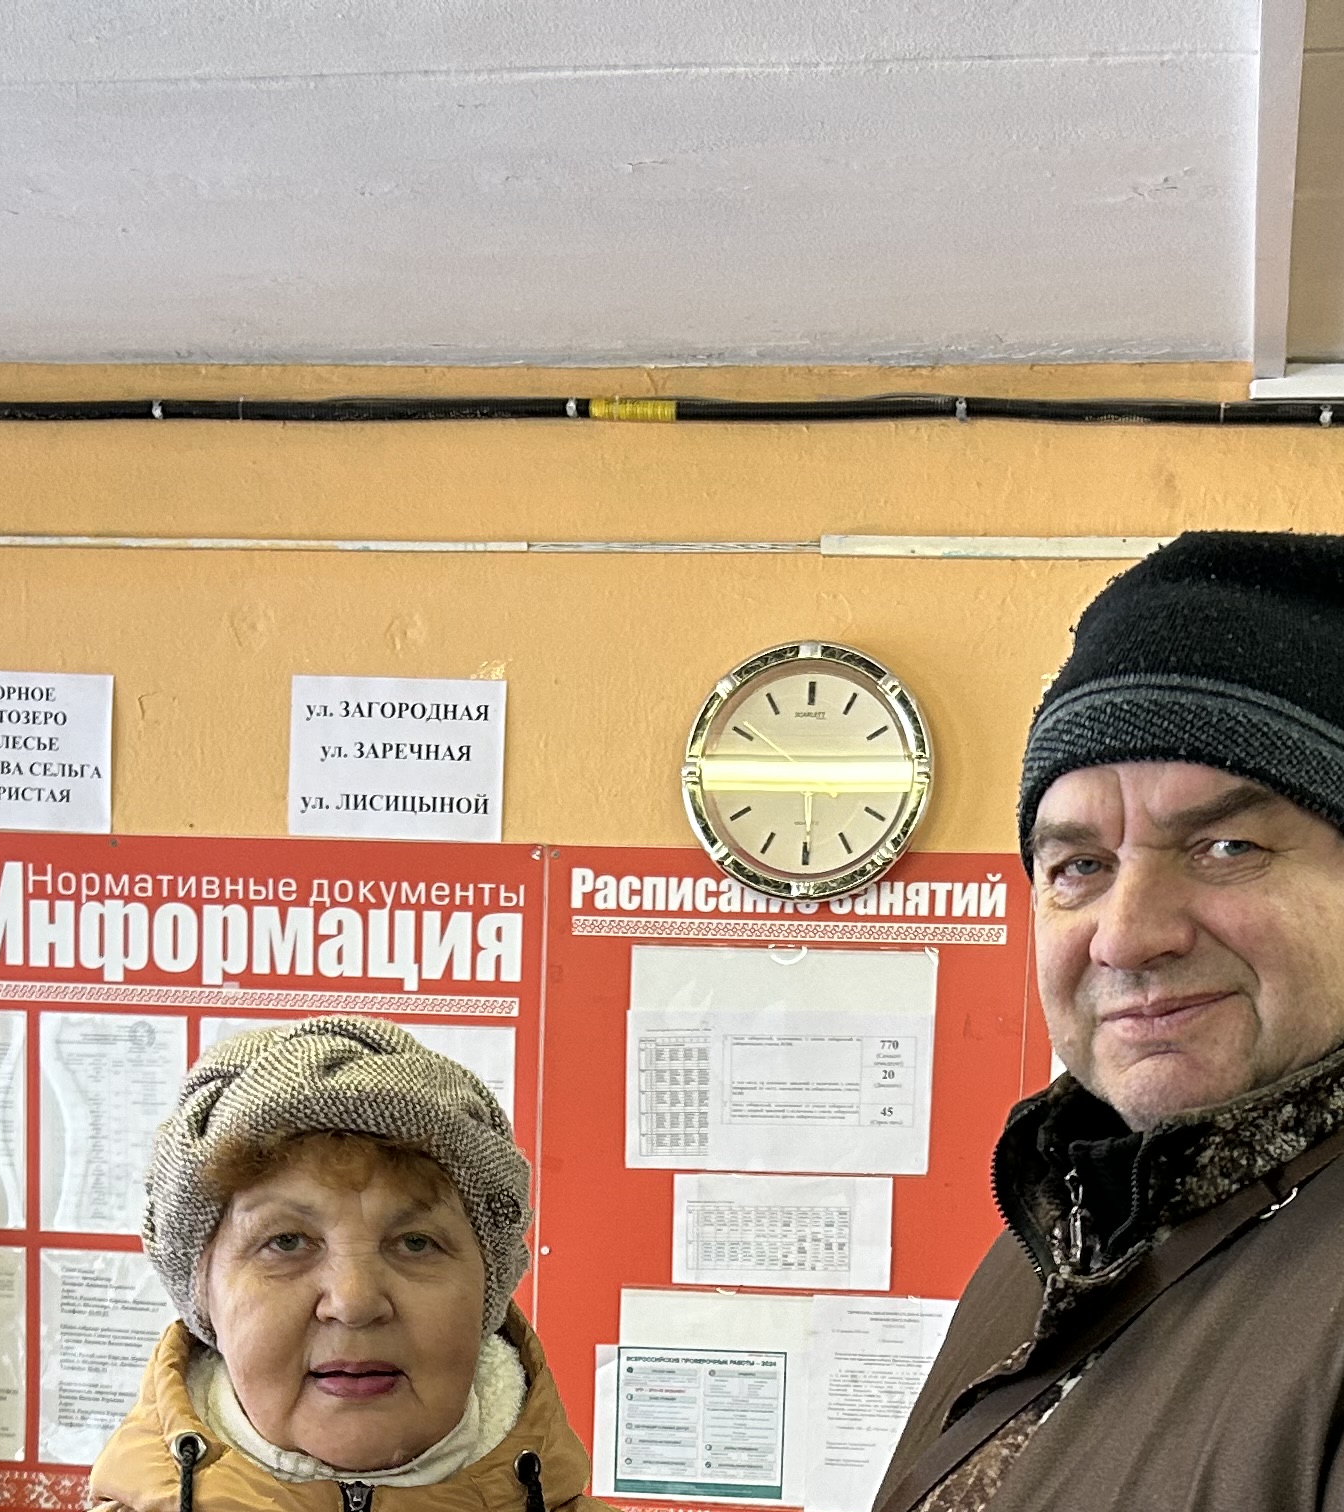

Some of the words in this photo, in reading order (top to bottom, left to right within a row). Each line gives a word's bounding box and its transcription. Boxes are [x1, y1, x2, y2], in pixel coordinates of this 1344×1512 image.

[306, 704, 334, 721] ул.
[339, 701, 490, 722] ЗАГОРОДНАЯ
[320, 745, 348, 762] ул.
[353, 741, 472, 762] ЗАРЕЧНАЯ
[29, 762, 102, 779] СЕЛЬГА
[300, 795, 330, 813] ул.
[335, 793, 490, 815] ЛИСИЦЫНОЙ
[27, 862, 298, 903] Нормативные
[309, 876, 525, 911] документы
[880, 1040, 899, 1050] 770
[882, 1069, 895, 1080] 20
[880, 1107, 894, 1117] 45
